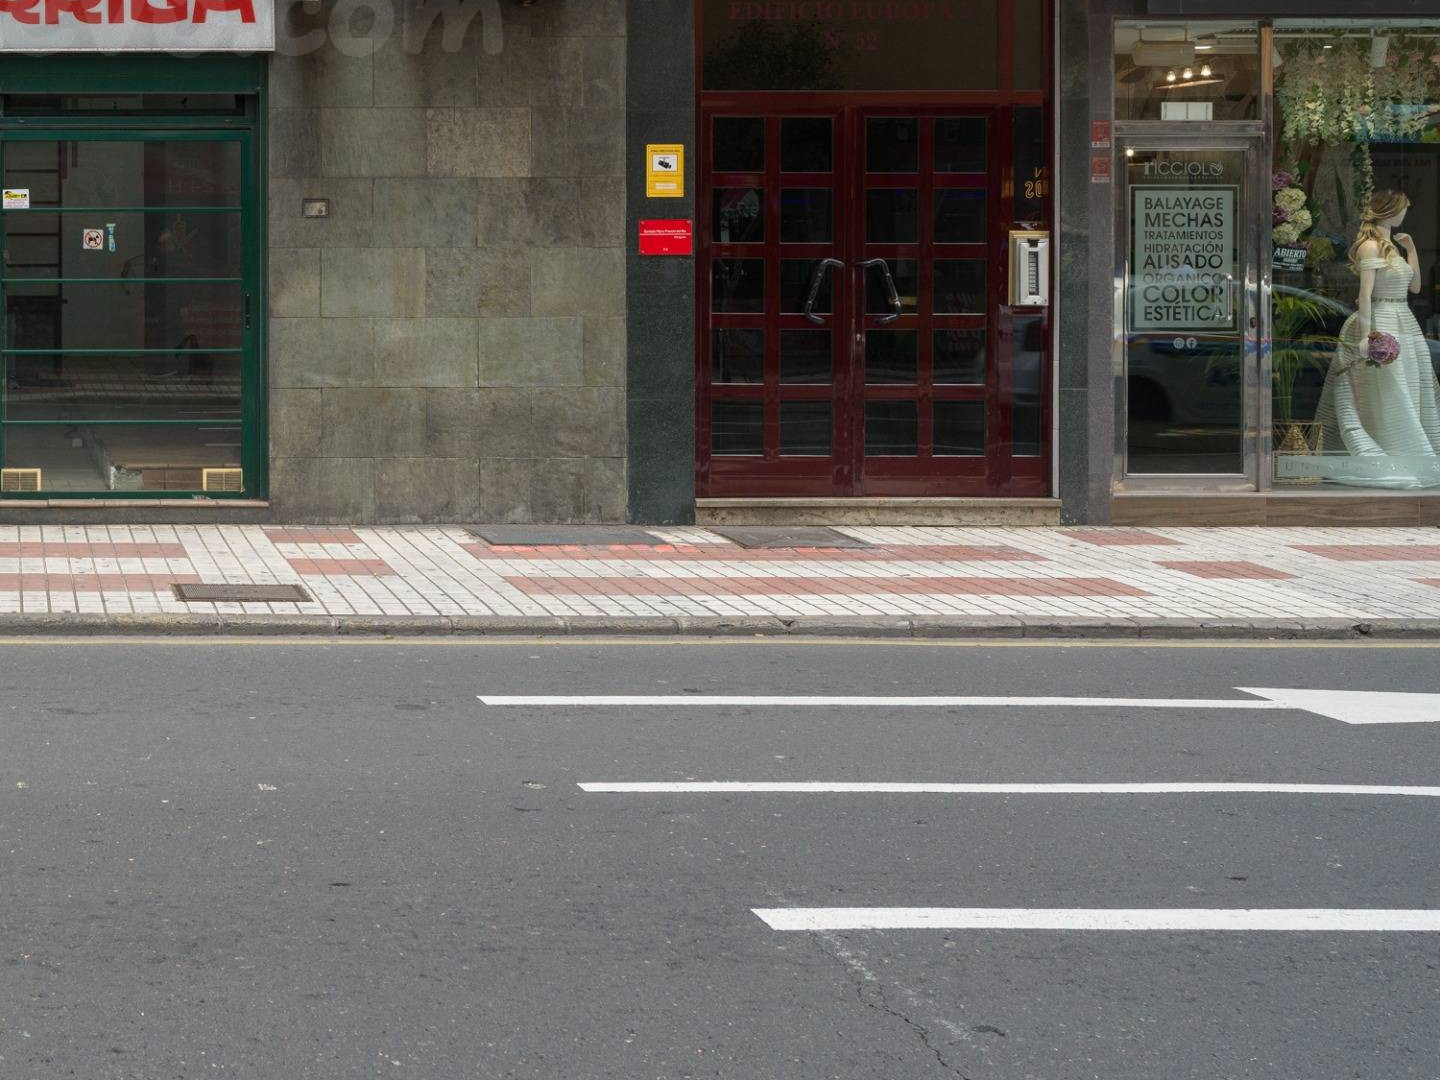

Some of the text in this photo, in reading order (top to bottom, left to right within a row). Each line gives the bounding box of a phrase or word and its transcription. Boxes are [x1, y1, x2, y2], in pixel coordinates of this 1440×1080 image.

[1144, 197, 1224, 210] BALAYAGE
[1144, 212, 1224, 228] MECHAS
[1144, 230, 1224, 241] TRATAMIENTOS
[1144, 241, 1224, 254] HIDRATACIÓN
[1274, 247, 1307, 258] ABIERTO
[1143, 254, 1224, 269] ALISADO
[1143, 285, 1224, 304] COLOR
[1144, 300, 1224, 321] ESTÉTICA
